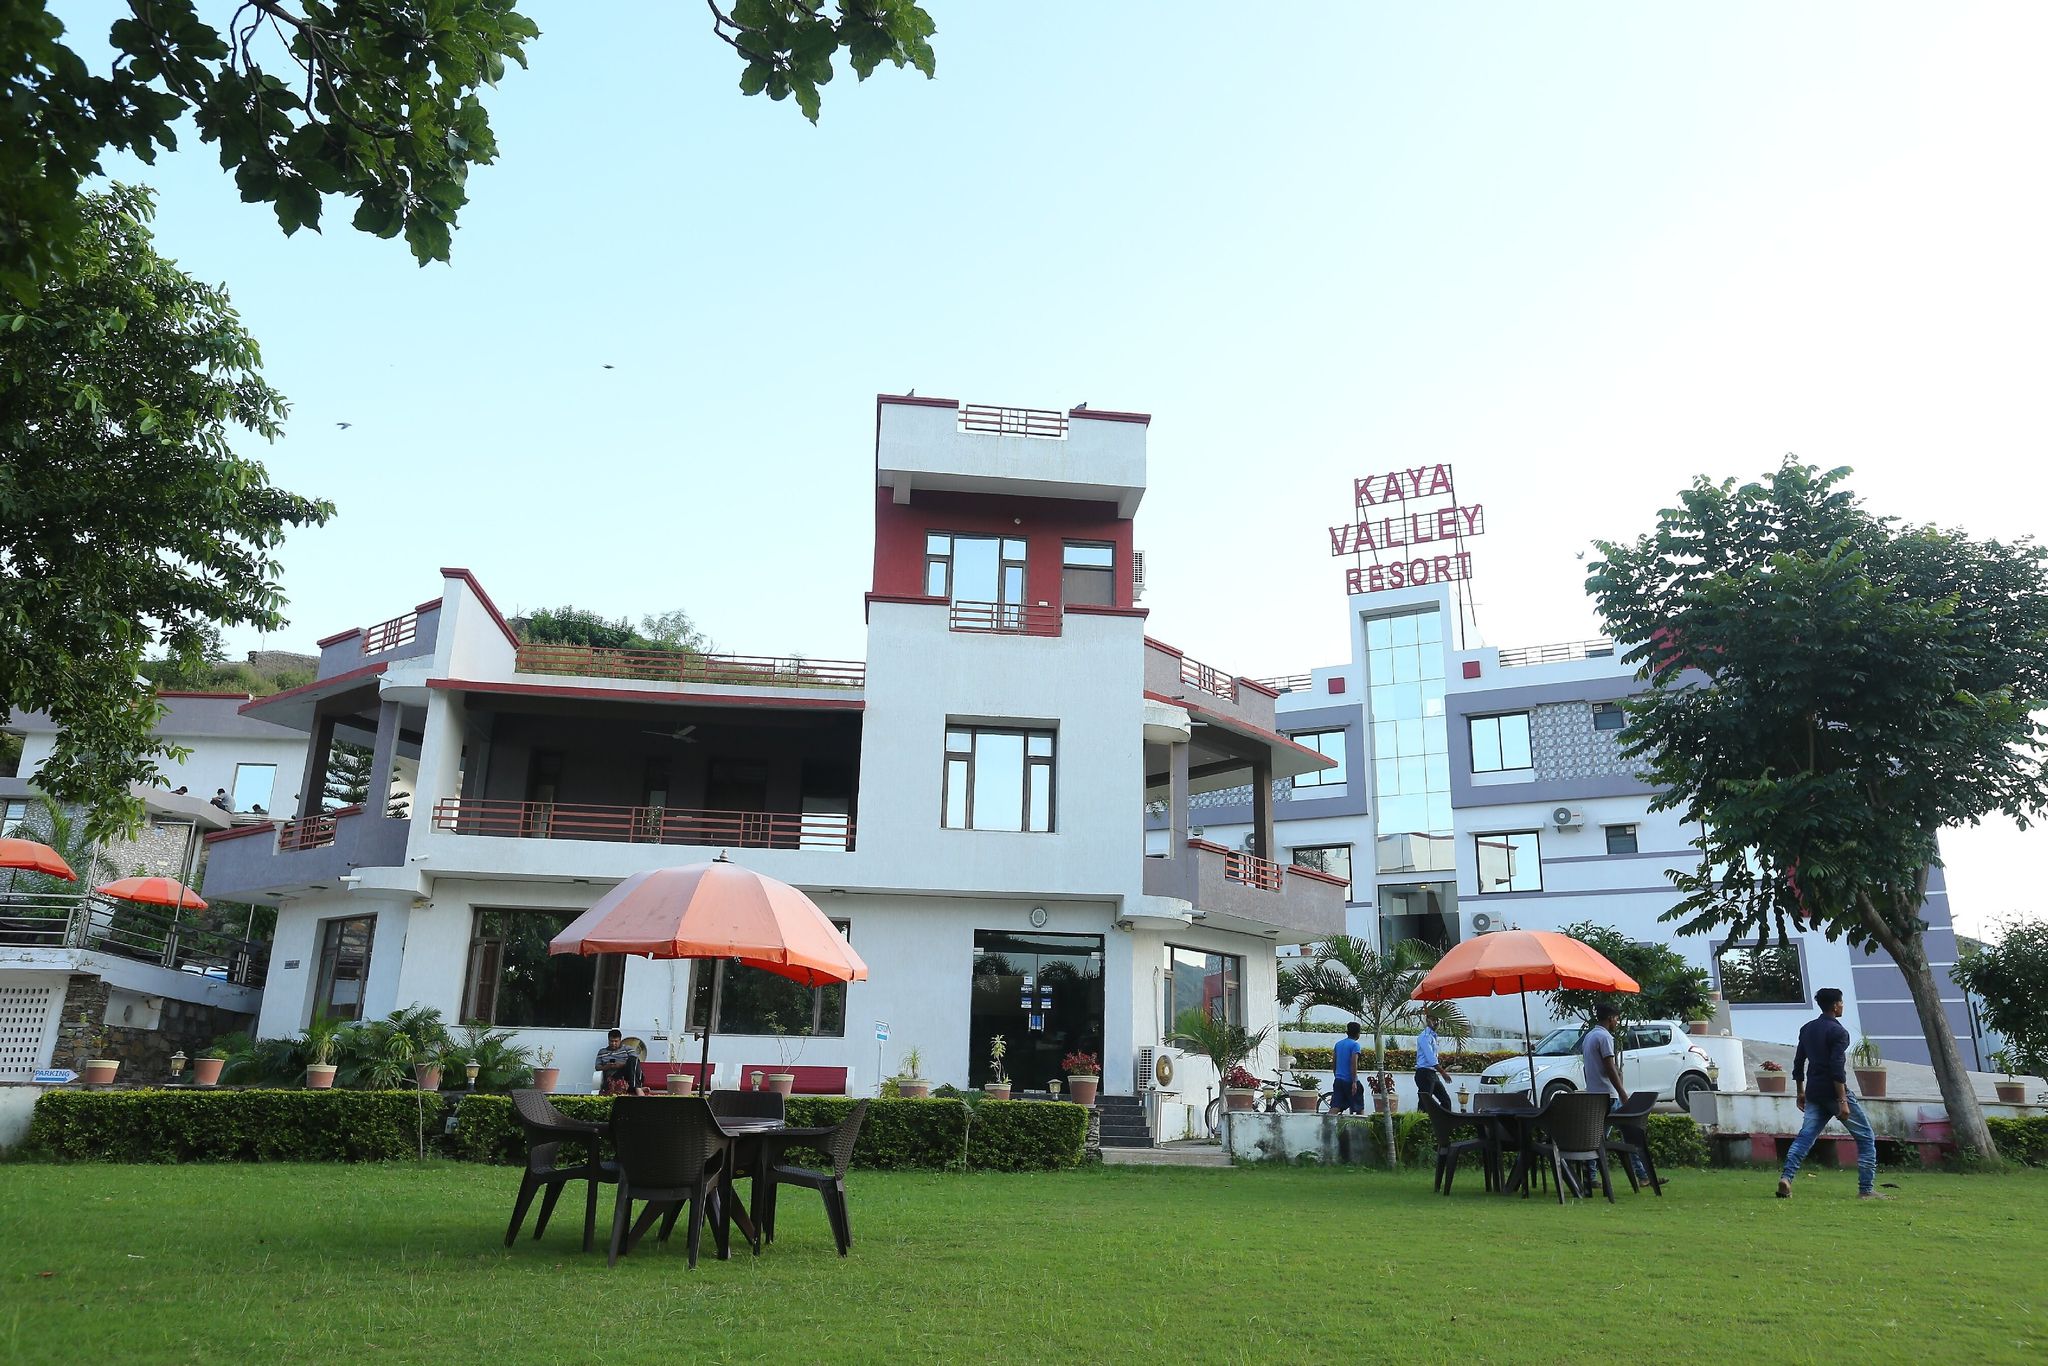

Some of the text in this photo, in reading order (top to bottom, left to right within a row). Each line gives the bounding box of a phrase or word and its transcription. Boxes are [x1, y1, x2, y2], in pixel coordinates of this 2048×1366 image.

[1354, 464, 1452, 507] KAYA
[1328, 504, 1482, 555] VALLEY
[1346, 552, 1471, 595] RESORT
